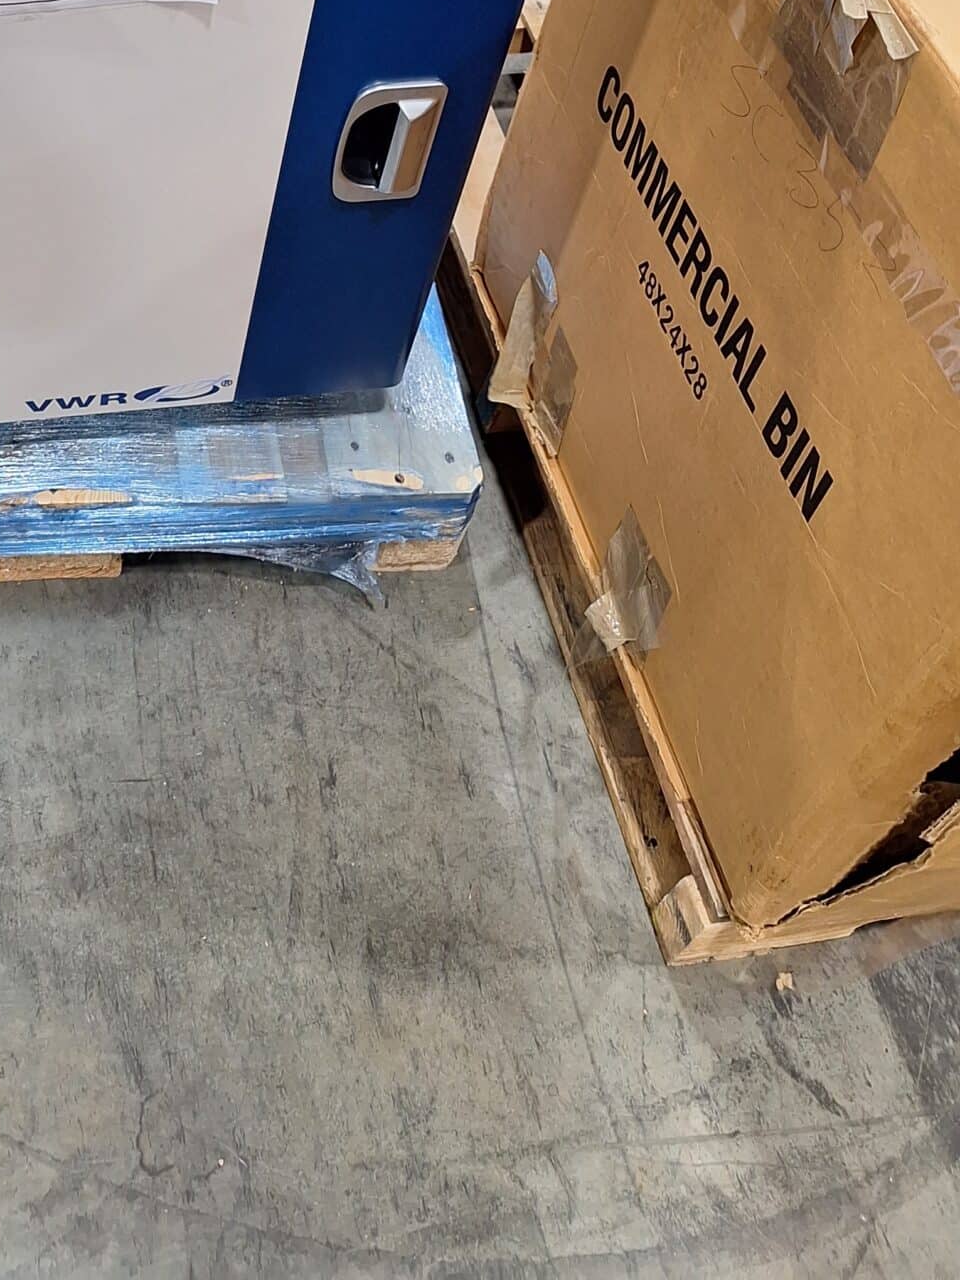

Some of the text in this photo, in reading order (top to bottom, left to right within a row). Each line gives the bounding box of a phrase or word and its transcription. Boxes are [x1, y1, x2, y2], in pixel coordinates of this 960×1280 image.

[596, 64, 835, 523] COMMERCIAL BIN
[637, 259, 708, 401] 48X24X28
[25, 392, 128, 412] VWR
